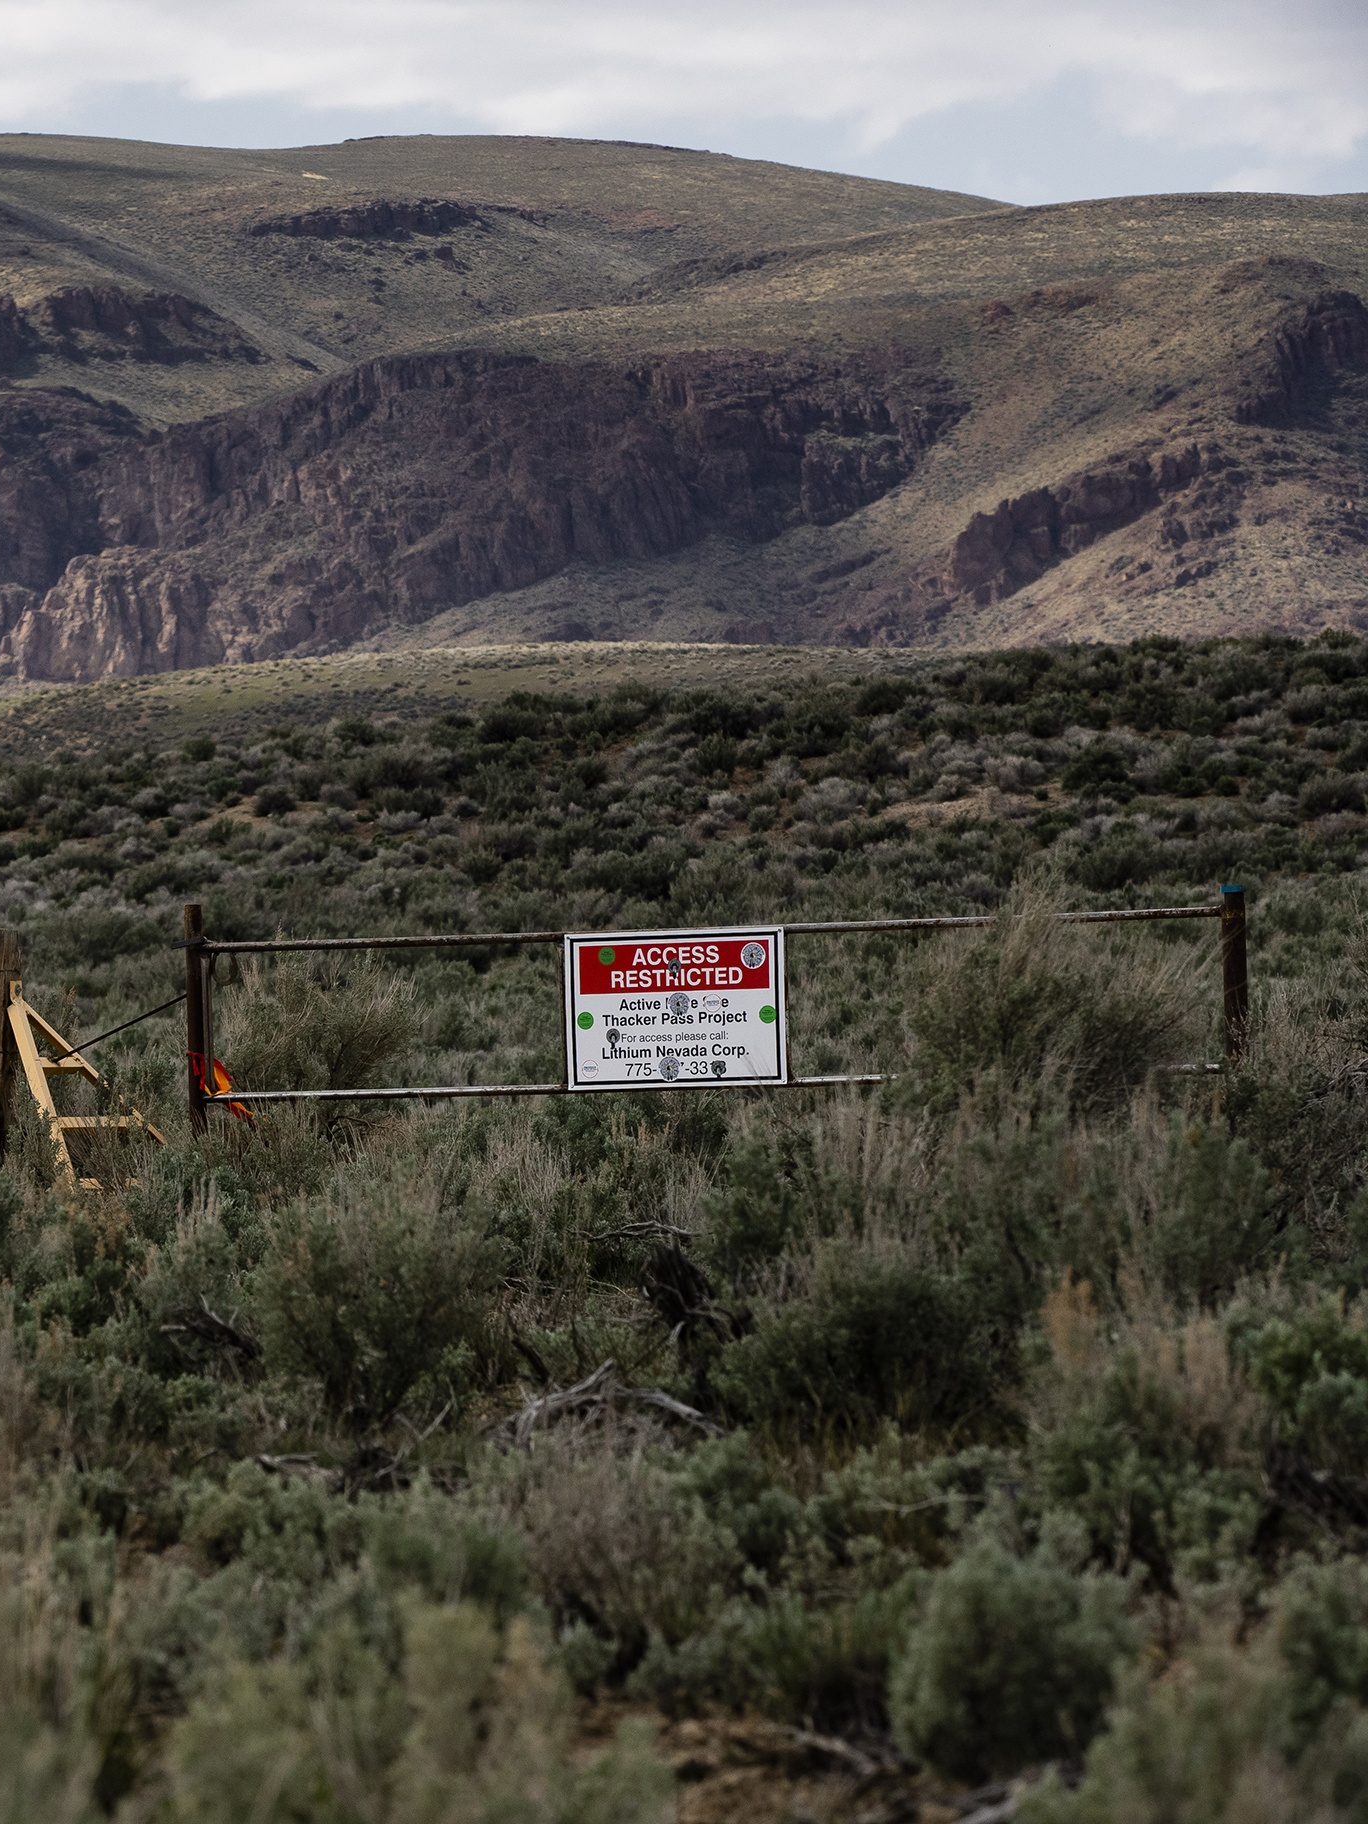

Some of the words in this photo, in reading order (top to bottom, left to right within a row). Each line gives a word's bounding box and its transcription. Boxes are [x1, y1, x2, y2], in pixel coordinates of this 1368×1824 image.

[632, 945, 720, 966] ACCESS
[610, 967, 744, 989] RESTRICTED
[619, 998, 661, 1011] Active
[602, 1014, 657, 1027] Thacker
[661, 1012, 694, 1025] Pass
[698, 1010, 748, 1026] Project
[621, 1033, 637, 1043] For
[639, 1033, 673, 1043] access
[675, 1031, 707, 1045] please
[709, 1030, 729, 1041] call:
[602, 1046, 651, 1060] Lithium
[656, 1044, 707, 1059] Nevada
[712, 1043, 750, 1058] Corp.
[624, 1060, 727, 1077] 775--33
